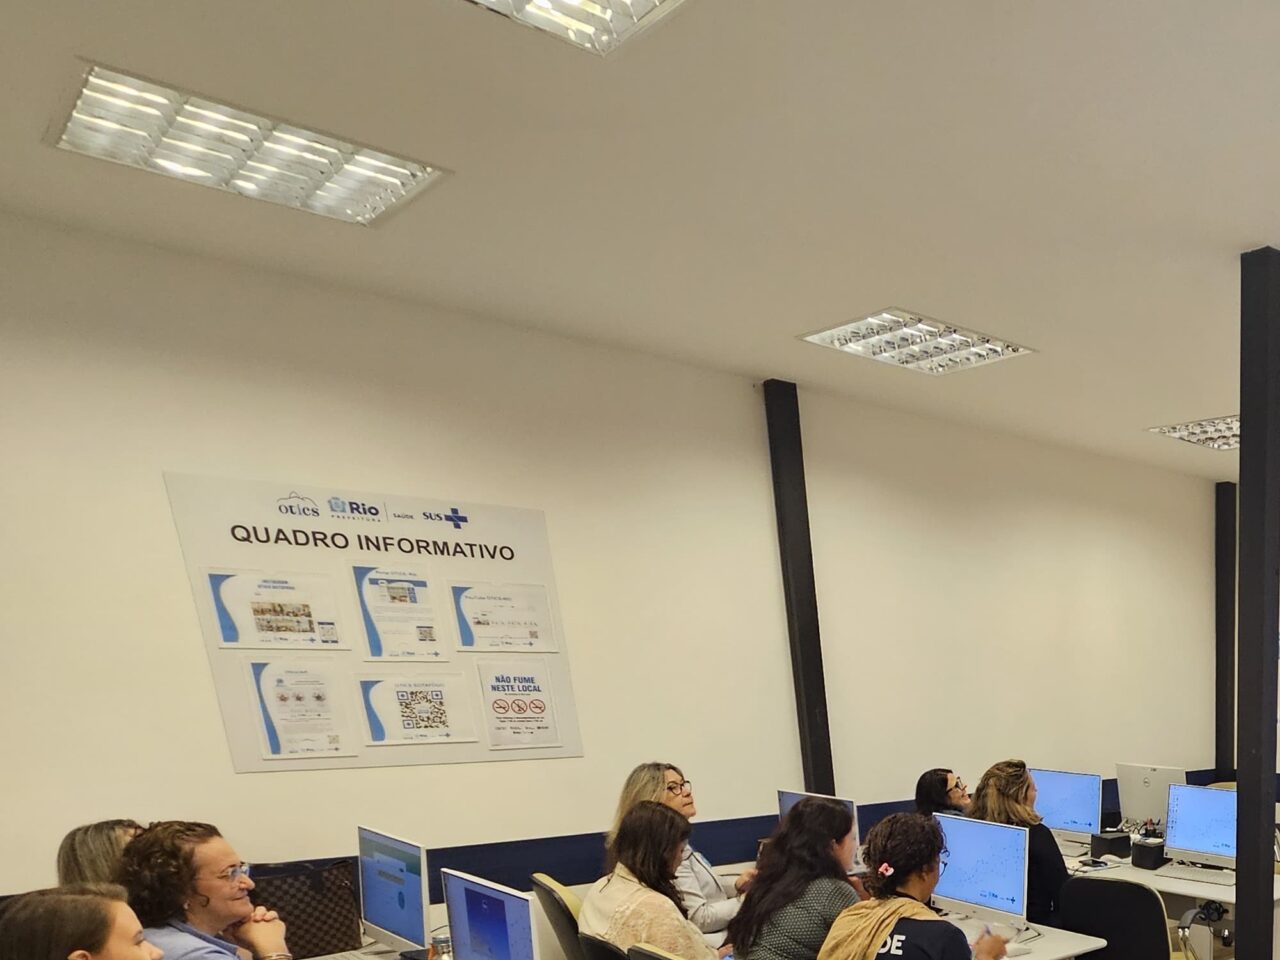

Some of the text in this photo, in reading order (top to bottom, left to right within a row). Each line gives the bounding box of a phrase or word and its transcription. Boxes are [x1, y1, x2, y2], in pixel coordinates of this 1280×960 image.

[278, 502, 320, 518] otics
[349, 501, 380, 517] Rio
[422, 511, 443, 521] SUS
[230, 524, 515, 561] QUADRO INFORMATIVO
[494, 674, 535, 684] NÃO FUME
[491, 684, 542, 693] NESTE LOCAL
